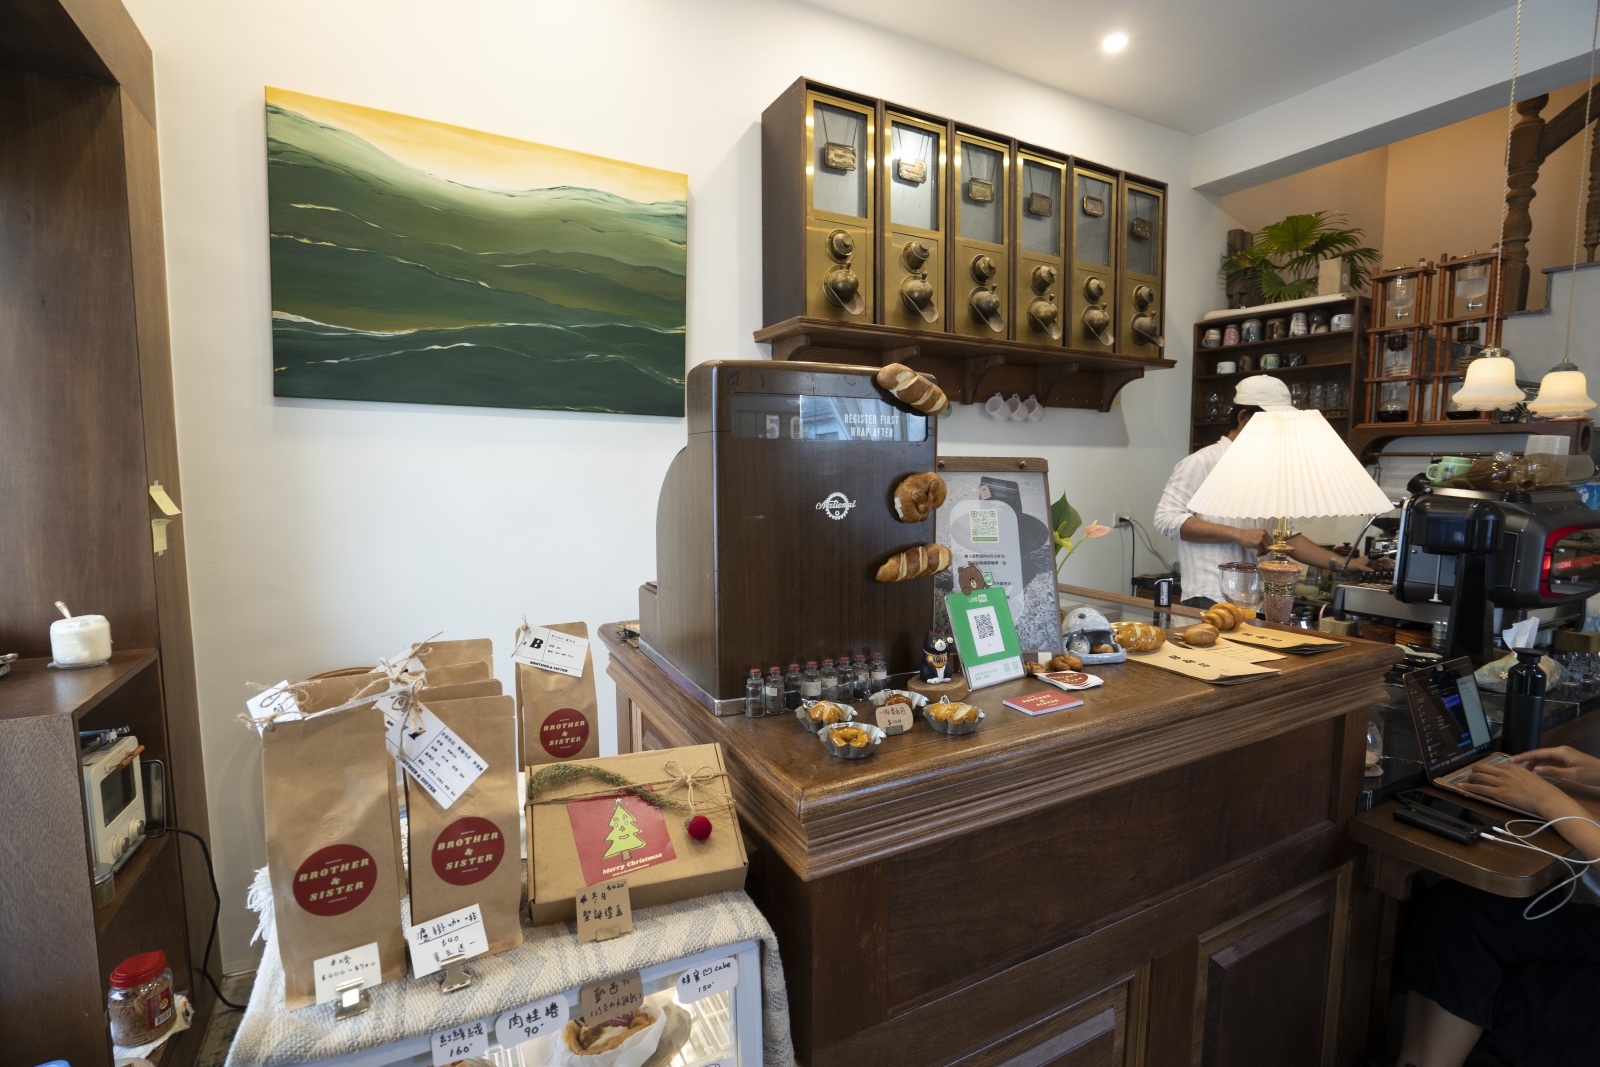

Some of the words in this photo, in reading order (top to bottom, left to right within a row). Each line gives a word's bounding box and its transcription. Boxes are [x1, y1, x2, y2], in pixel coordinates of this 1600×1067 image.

[844, 414, 876, 424] REGISTER
[880, 415, 899, 425] FIRST
[850, 427, 870, 437] WRAP
[873, 428, 894, 437] AFTER
[815, 499, 856, 510] National
[529, 637, 544, 649] B
[543, 720, 585, 731] BROTHER
[548, 736, 581, 746] SISTER
[420, 776, 437, 794] SISTER
[437, 832, 498, 851] BROTHER
[464, 848, 473, 856] &
[445, 853, 493, 870] SISTER
[602, 864, 625, 875] Merry
[627, 853, 663, 867] Christmas
[299, 858, 369, 882] BROTHER
[330, 877, 341, 885] &
[309, 881, 364, 901] SISTER
[416, 911, 478, 943] 濾掛咖啡
[442, 935, 459, 947] $40
